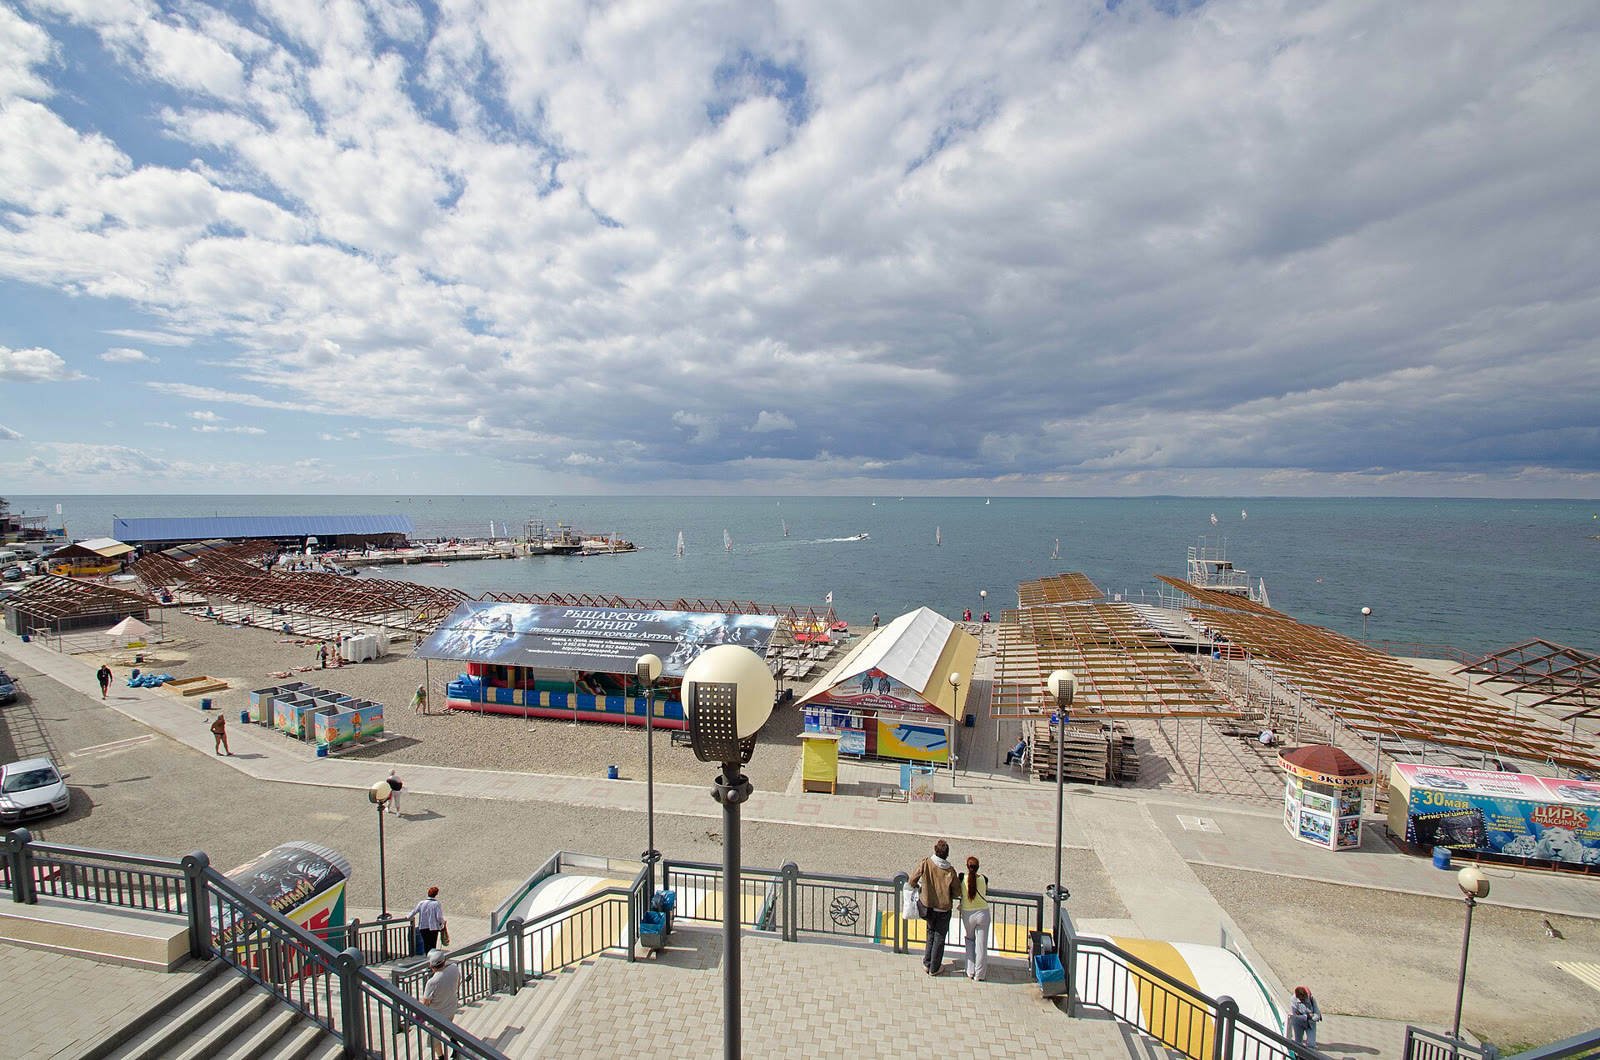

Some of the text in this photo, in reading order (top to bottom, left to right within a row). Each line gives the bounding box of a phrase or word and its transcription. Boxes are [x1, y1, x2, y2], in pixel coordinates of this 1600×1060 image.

[562, 609, 661, 623] РЫЦАРСКИЙ
[574, 619, 638, 631] ТУРНИР
[1422, 791, 1444, 806] 30
[1445, 799, 1469, 808] мая
[1534, 806, 1584, 821] ЦИРК
[1535, 817, 1584, 828] МАКСИМУС
